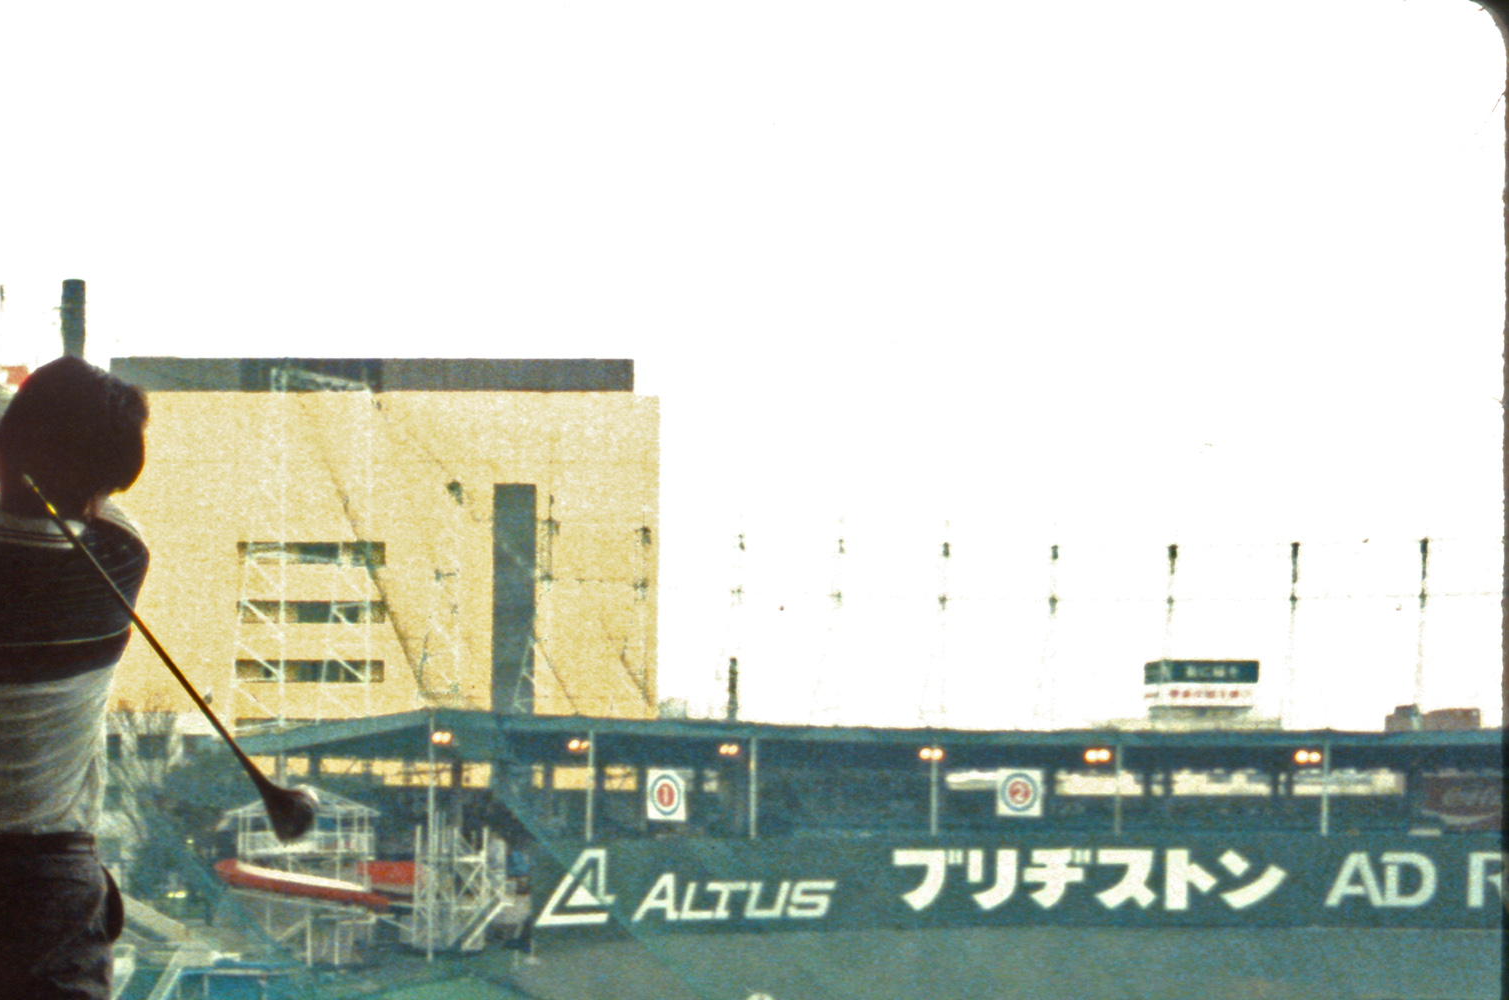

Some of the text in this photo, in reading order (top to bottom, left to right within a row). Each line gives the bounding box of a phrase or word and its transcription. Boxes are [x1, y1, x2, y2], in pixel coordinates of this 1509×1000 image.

[631, 872, 837, 921] ALTUS
[892, 848, 1288, 912] ブリヂストン
[1323, 852, 1438, 908] AD
